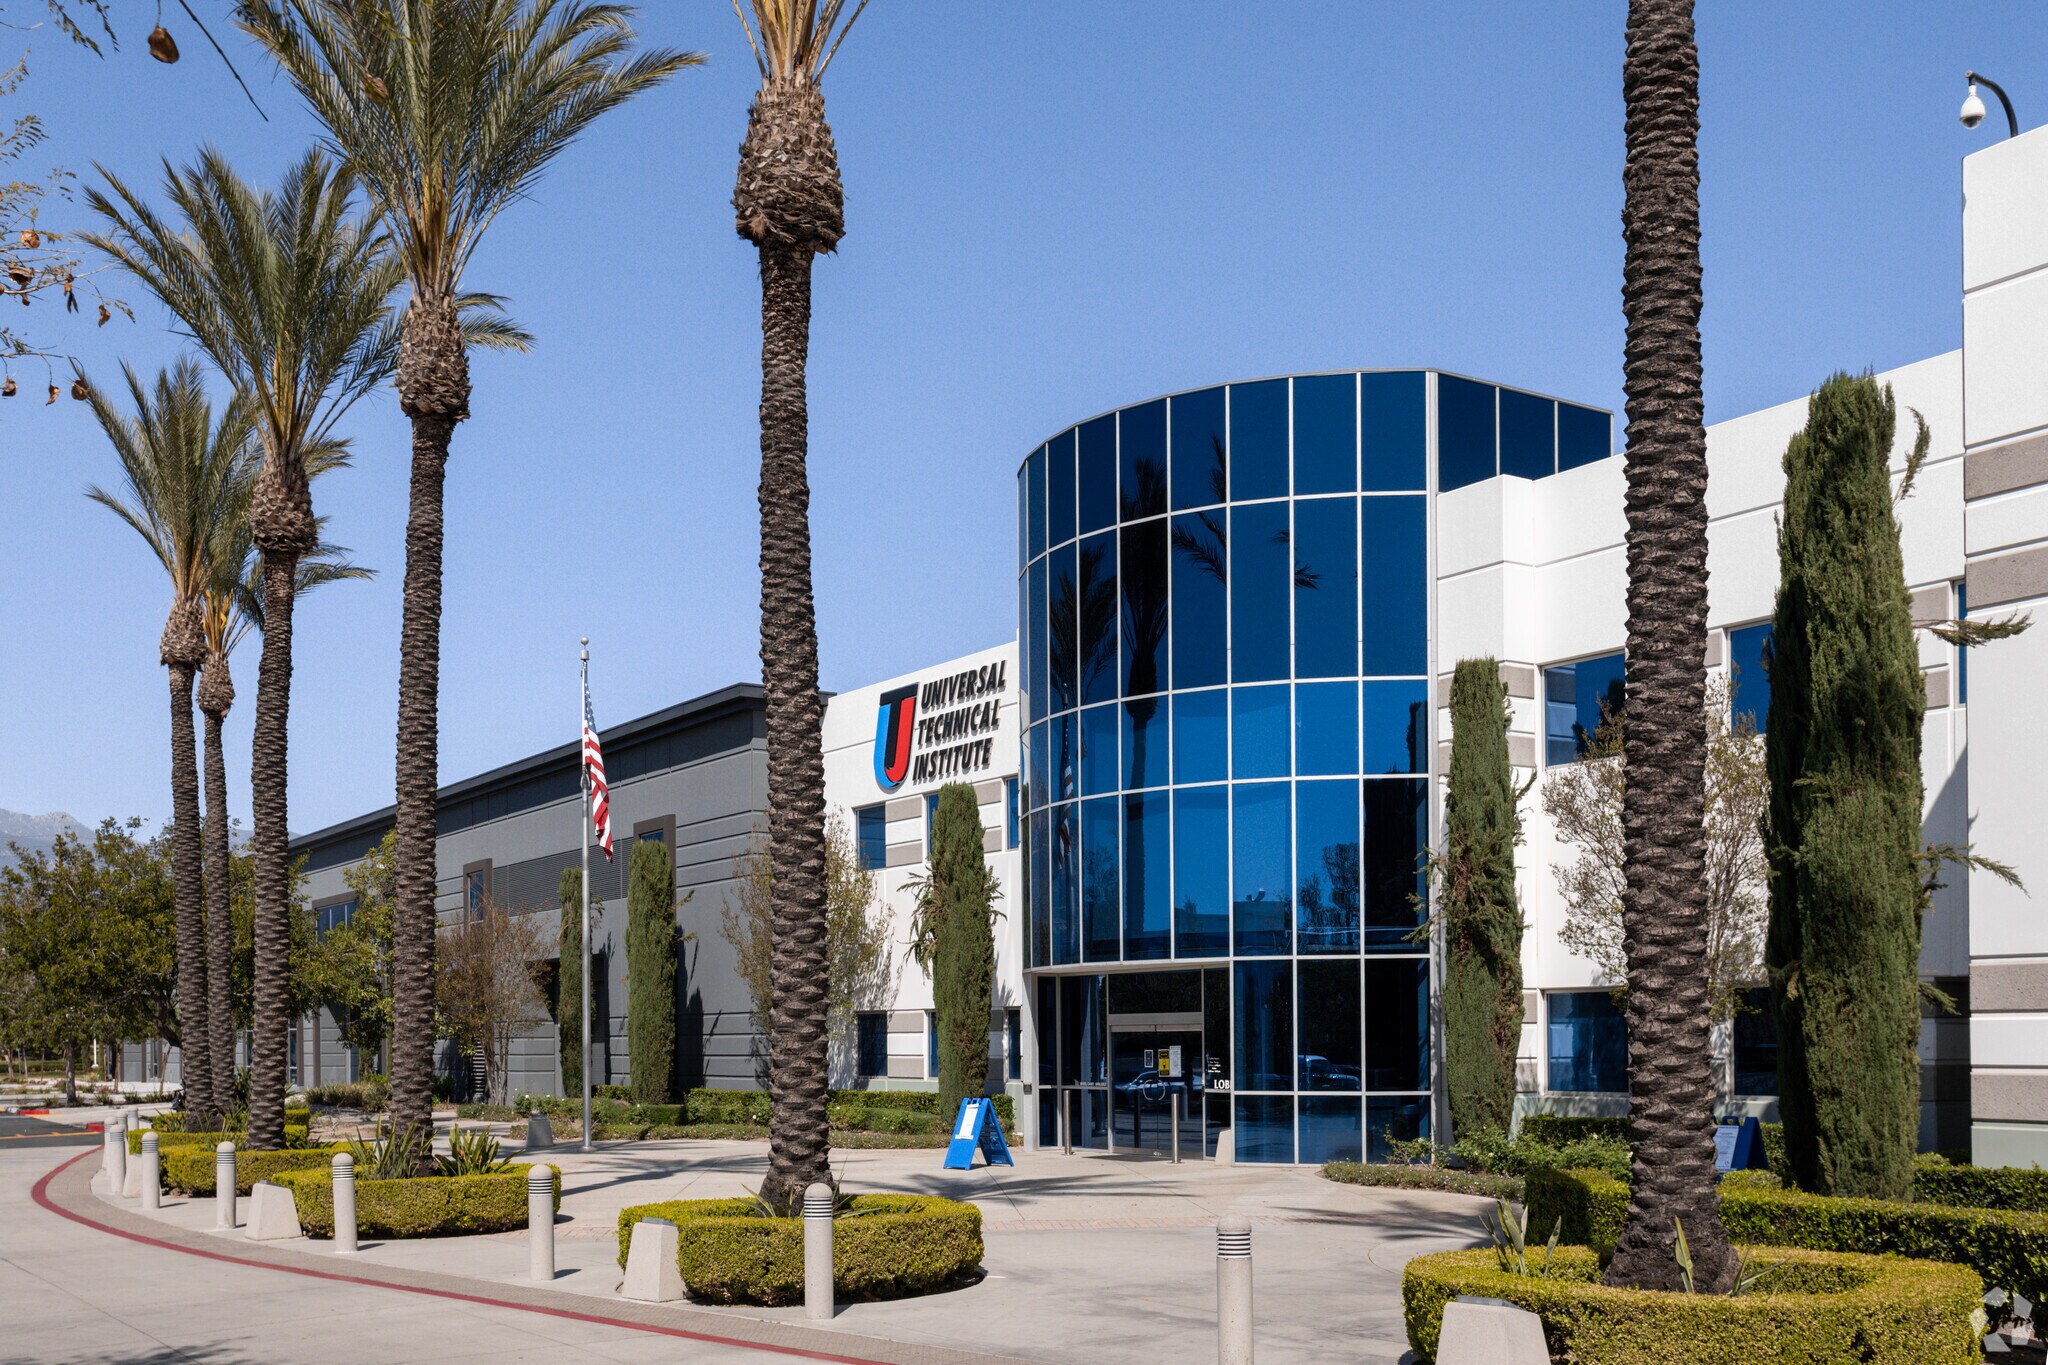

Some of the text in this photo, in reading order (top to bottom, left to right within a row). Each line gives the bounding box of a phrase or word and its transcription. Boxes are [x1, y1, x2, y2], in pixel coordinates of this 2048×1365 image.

[921, 660, 1007, 711] UNIVERSAL
[917, 699, 1000, 746] TECHNICAL
[912, 737, 994, 782] INSTITUTE
